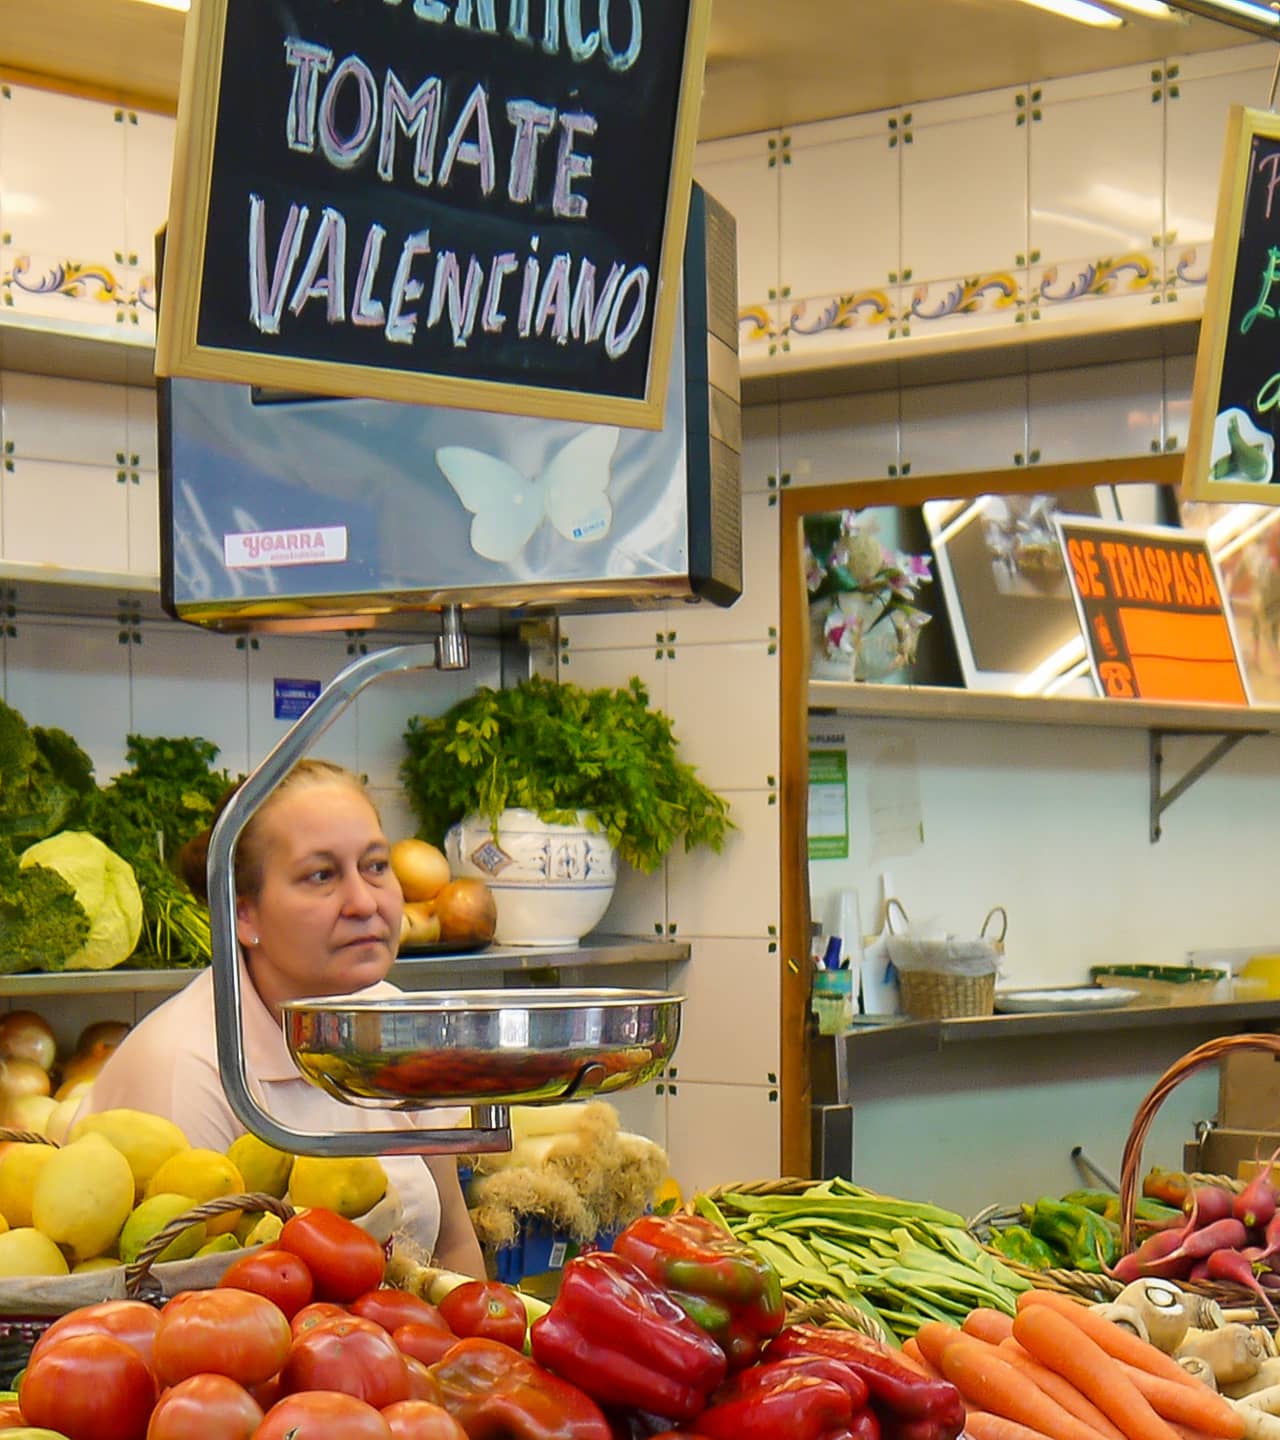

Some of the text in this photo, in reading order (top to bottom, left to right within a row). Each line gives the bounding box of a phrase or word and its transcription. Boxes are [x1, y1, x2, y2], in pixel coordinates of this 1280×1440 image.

[285, 36, 598, 218] TOMATE
[1067, 538, 1222, 609] SE TRASPASA
